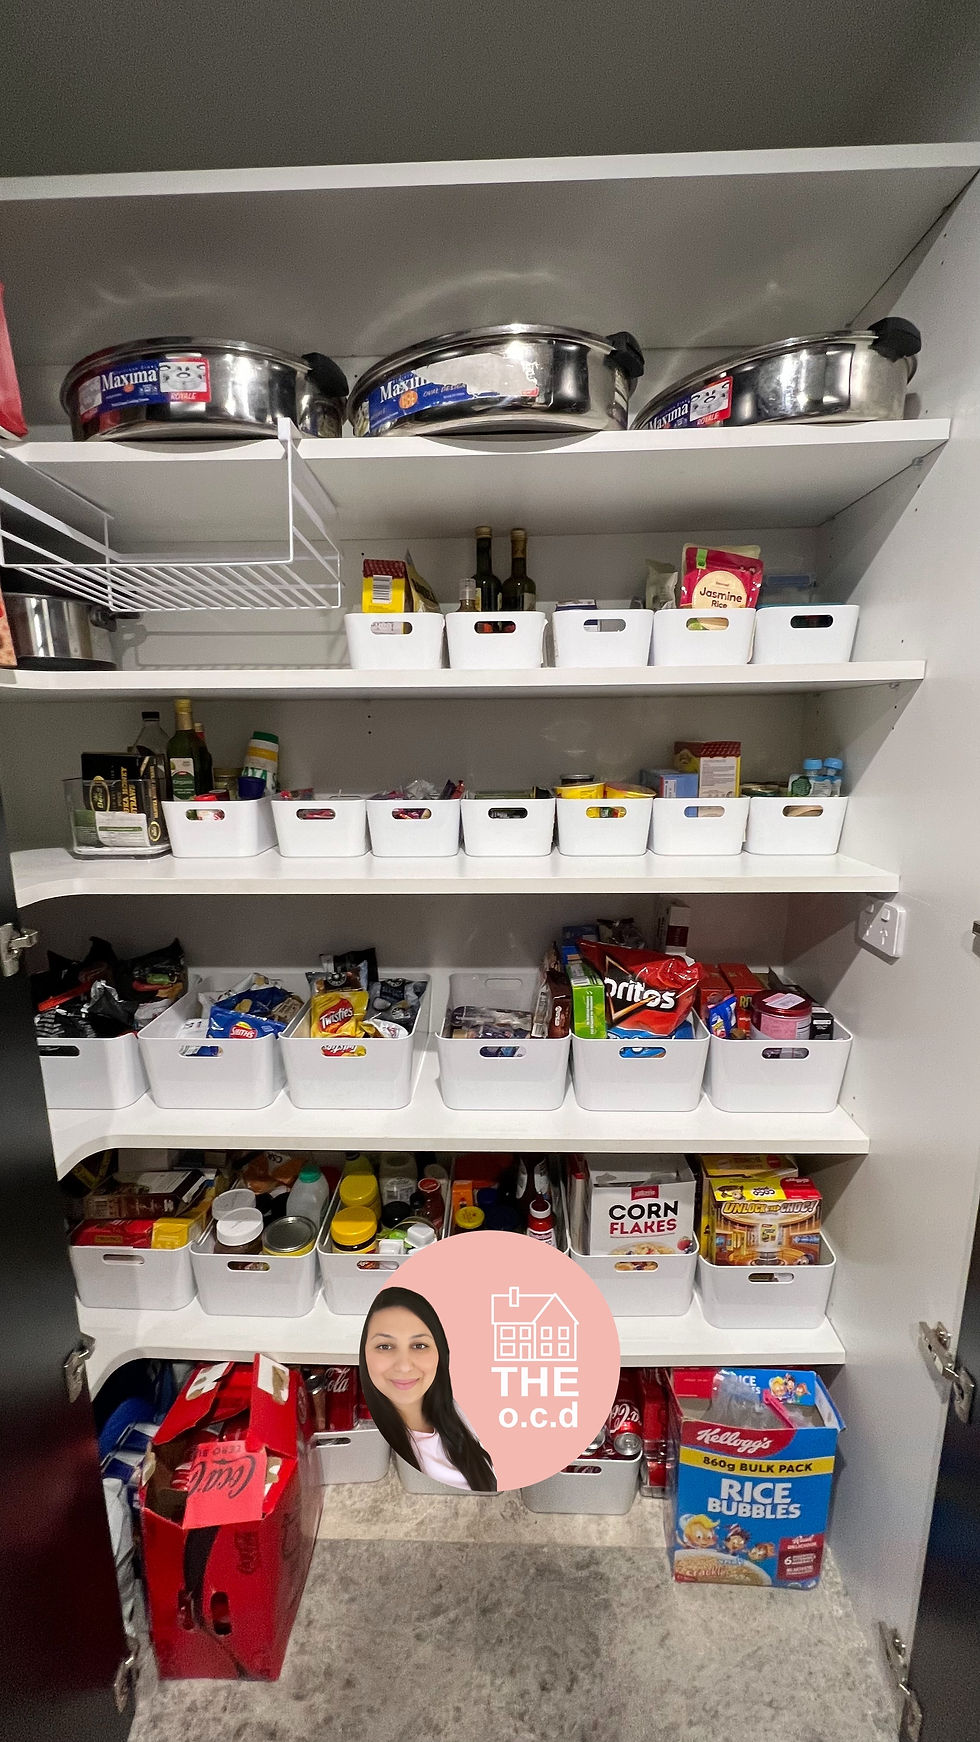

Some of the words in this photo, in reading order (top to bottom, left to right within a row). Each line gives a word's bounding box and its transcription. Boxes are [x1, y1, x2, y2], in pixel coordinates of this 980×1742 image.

[101, 370, 158, 392] Maxima
[699, 587, 743, 603] Jasmine
[711, 600, 728, 609] Rice
[319, 1006, 353, 1029] Twisties
[608, 1200, 679, 1220] CORN
[723, 1202, 767, 1213] UNLOCK
[609, 1218, 677, 1235] FLAKES
[696, 1428, 773, 1454] Kellogg's
[703, 1456, 736, 1472] 860g
[740, 1463, 775, 1473] BULK
[779, 1462, 813, 1473] PACK
[720, 1478, 792, 1504] RICE
[707, 1497, 801, 1519] BUBBLES
[784, 1556, 793, 1566] 6
